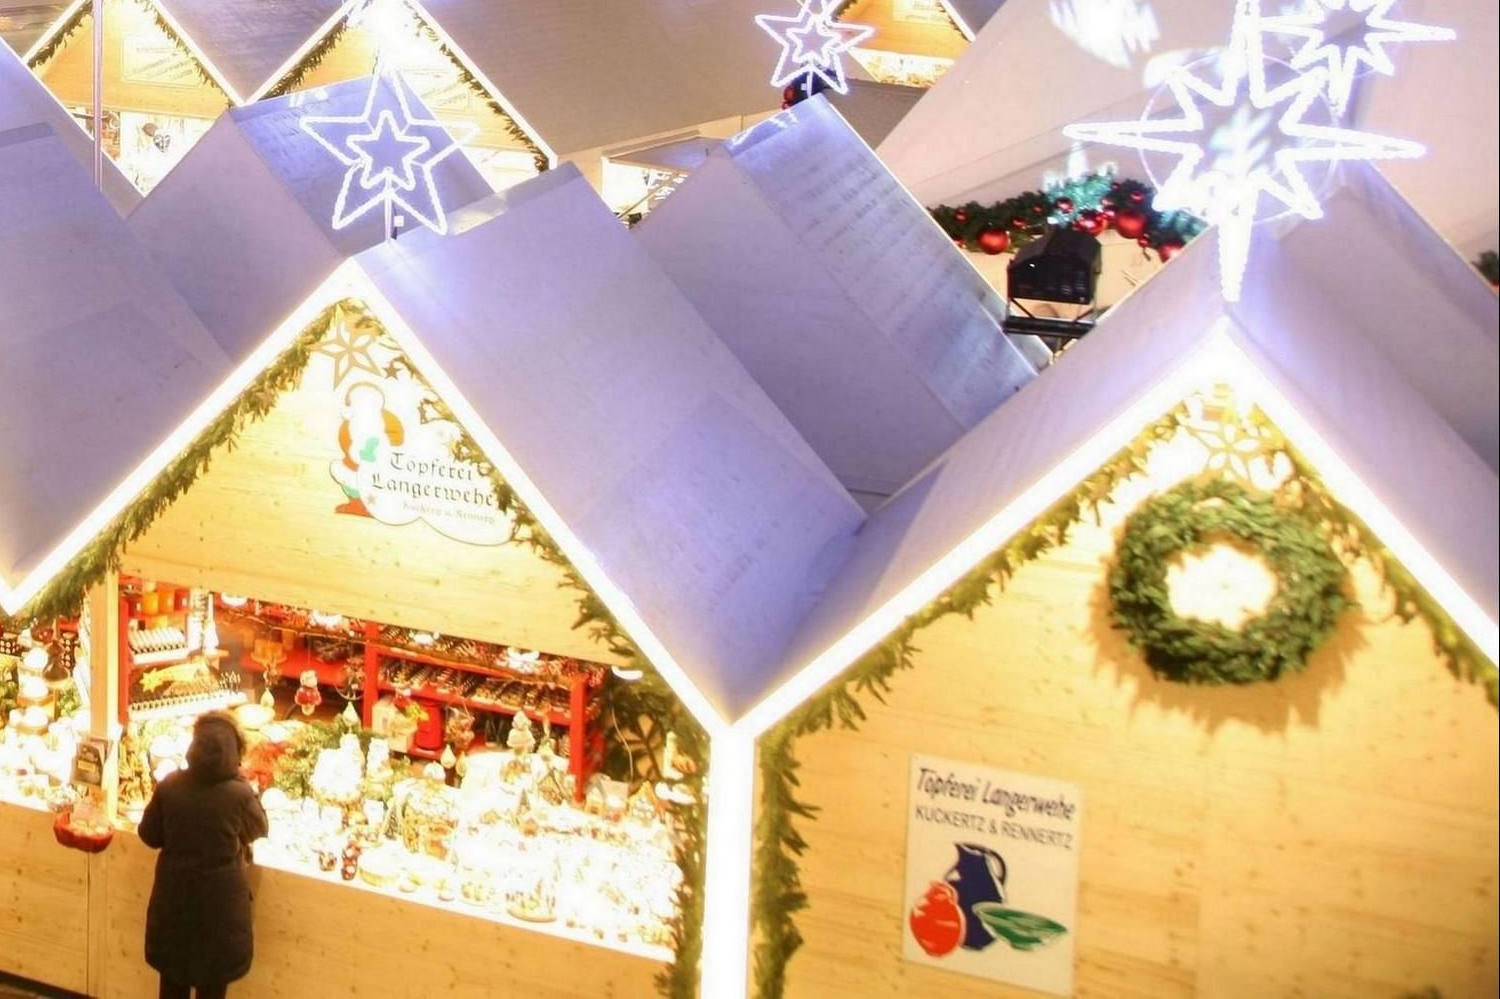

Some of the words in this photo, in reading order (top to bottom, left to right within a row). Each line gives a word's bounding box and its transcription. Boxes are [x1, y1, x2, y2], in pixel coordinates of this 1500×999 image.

[372, 472, 494, 507] Langerwehe
[981, 780, 1076, 820] Langerwehe
[915, 805, 985, 833] KUCKERTZ
[988, 818, 998, 835] &
[1001, 820, 1073, 850] RENNERTZ
